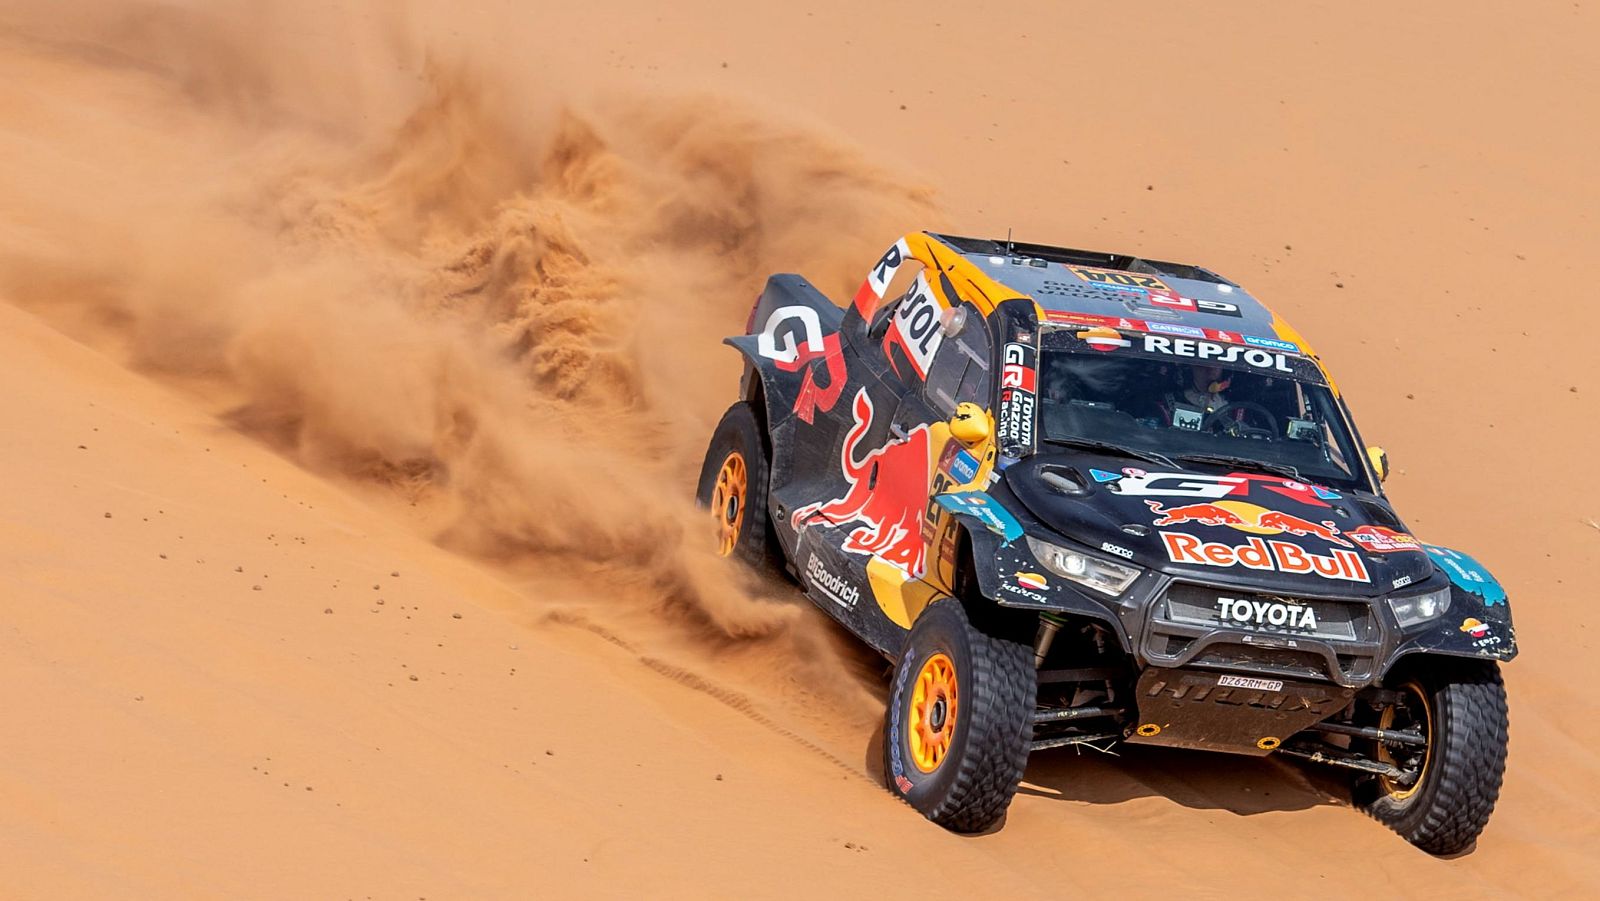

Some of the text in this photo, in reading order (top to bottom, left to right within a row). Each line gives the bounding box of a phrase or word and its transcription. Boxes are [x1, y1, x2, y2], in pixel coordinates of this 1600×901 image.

[1075, 269, 1165, 290] 204
[1144, 334, 1293, 373] REPSOL
[1246, 336, 1296, 350] aramco
[1004, 344, 1024, 388] GR
[998, 390, 1012, 438] Racing
[1010, 390, 1023, 439] GAZOO
[1021, 395, 1034, 446] TOYOTA
[1101, 541, 1134, 559] sparco
[1161, 531, 1370, 582] Red Bull
[1217, 597, 1317, 629] TOYOTA
